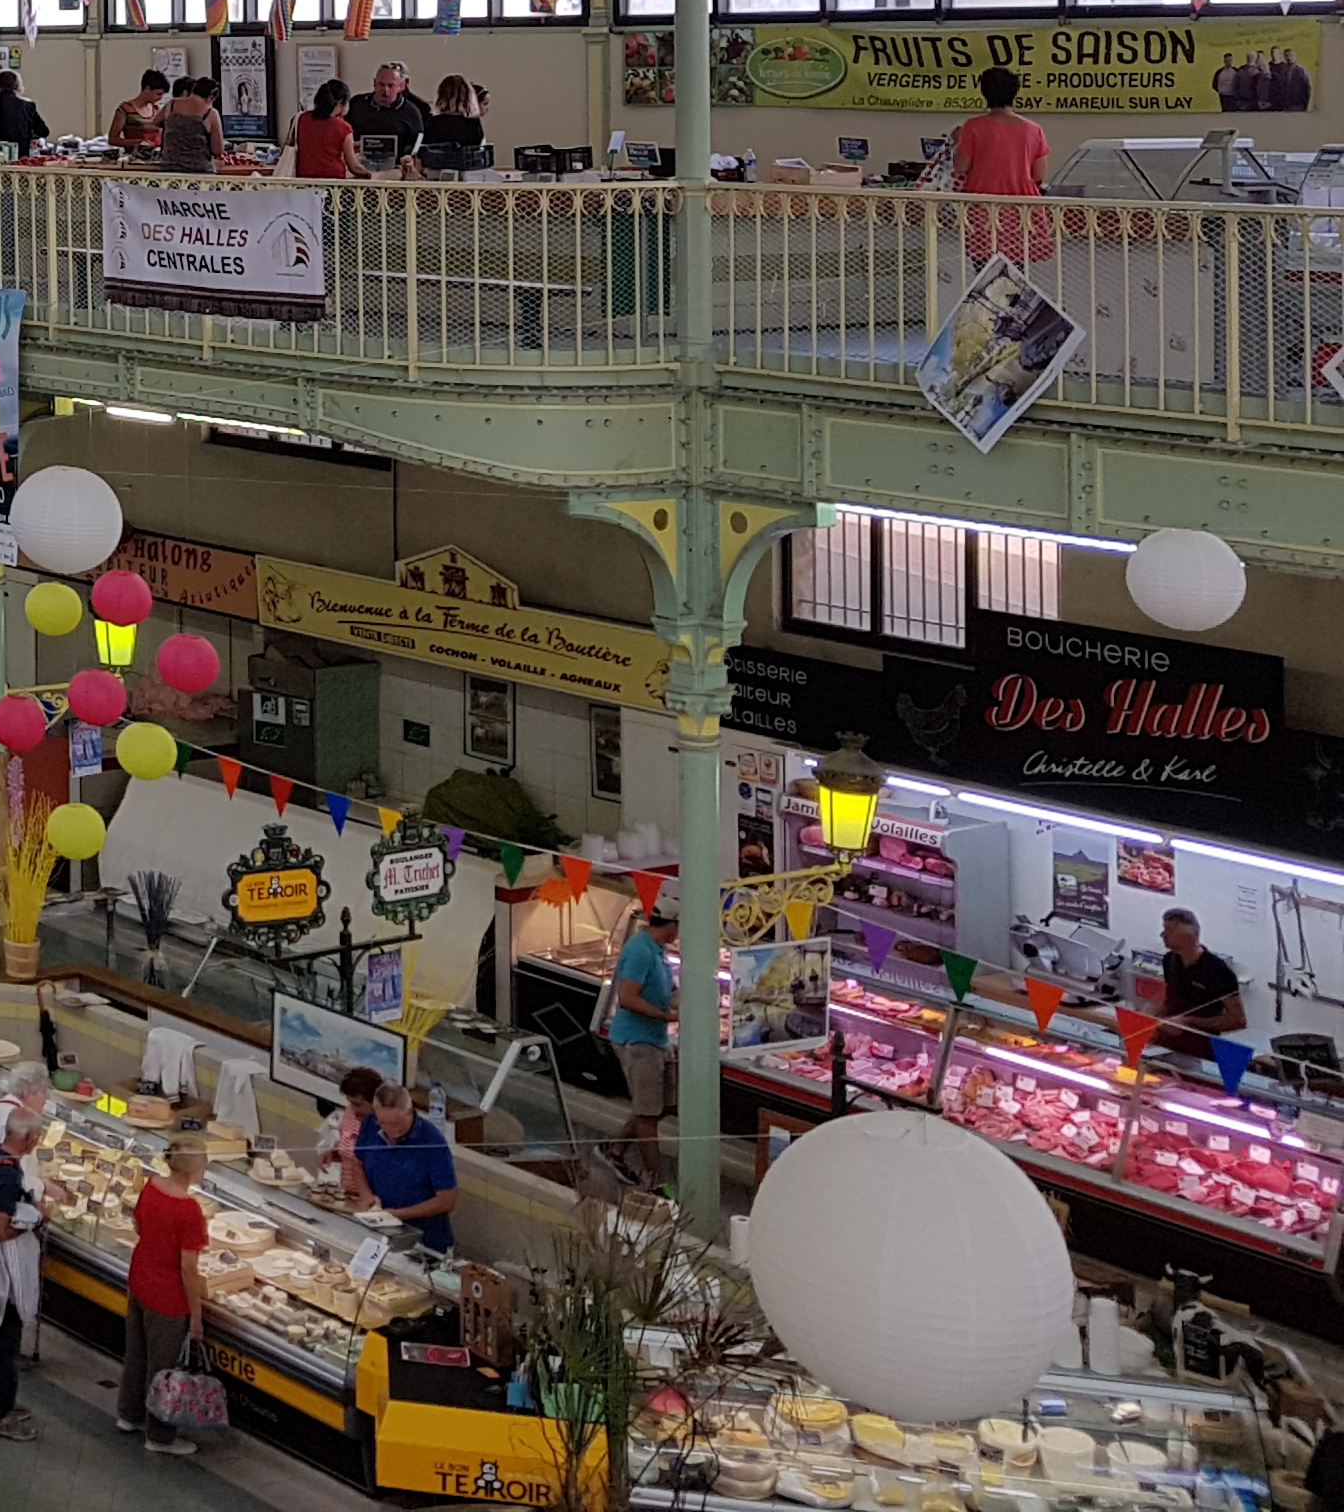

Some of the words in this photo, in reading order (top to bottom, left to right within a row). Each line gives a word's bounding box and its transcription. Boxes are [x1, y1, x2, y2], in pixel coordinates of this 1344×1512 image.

[852, 34, 973, 68] FRUITS
[986, 34, 1033, 67] DE
[1051, 30, 1195, 66] SAISON
[868, 72, 941, 90] VERGERS
[947, 75, 966, 90] DE
[1047, 72, 1175, 89] PRODUCTEURS
[944, 98, 982, 110] 85320
[1056, 96, 1124, 110] MAREUIL
[1129, 96, 1159, 110] SUR
[1164, 96, 1193, 110] LAY
[156, 199, 231, 221] MARCHE
[141, 223, 176, 242] DES
[180, 226, 249, 248] HALLES
[147, 249, 245, 276] CENTRALES
[134, 539, 212, 573] Halong
[308, 592, 393, 619] Bienvenue
[399, 604, 410, 620] à
[415, 607, 434, 624] la
[435, 605, 489, 635] Ferme
[495, 622, 518, 639] de
[521, 625, 542, 646] la
[429, 644, 477, 662] COCHON
[491, 656, 547, 677] VOLAILLE
[559, 672, 622, 693] AGNEAUX
[984, 674, 1086, 732] Des
[1104, 678, 1270, 744] Halles
[1023, 750, 1125, 779] Christelle
[1131, 758, 1153, 782] &
[389, 852, 433, 865] BOULANGER
[248, 883, 309, 901] TERROIR
[435, 1471, 551, 1503] TERROIR
